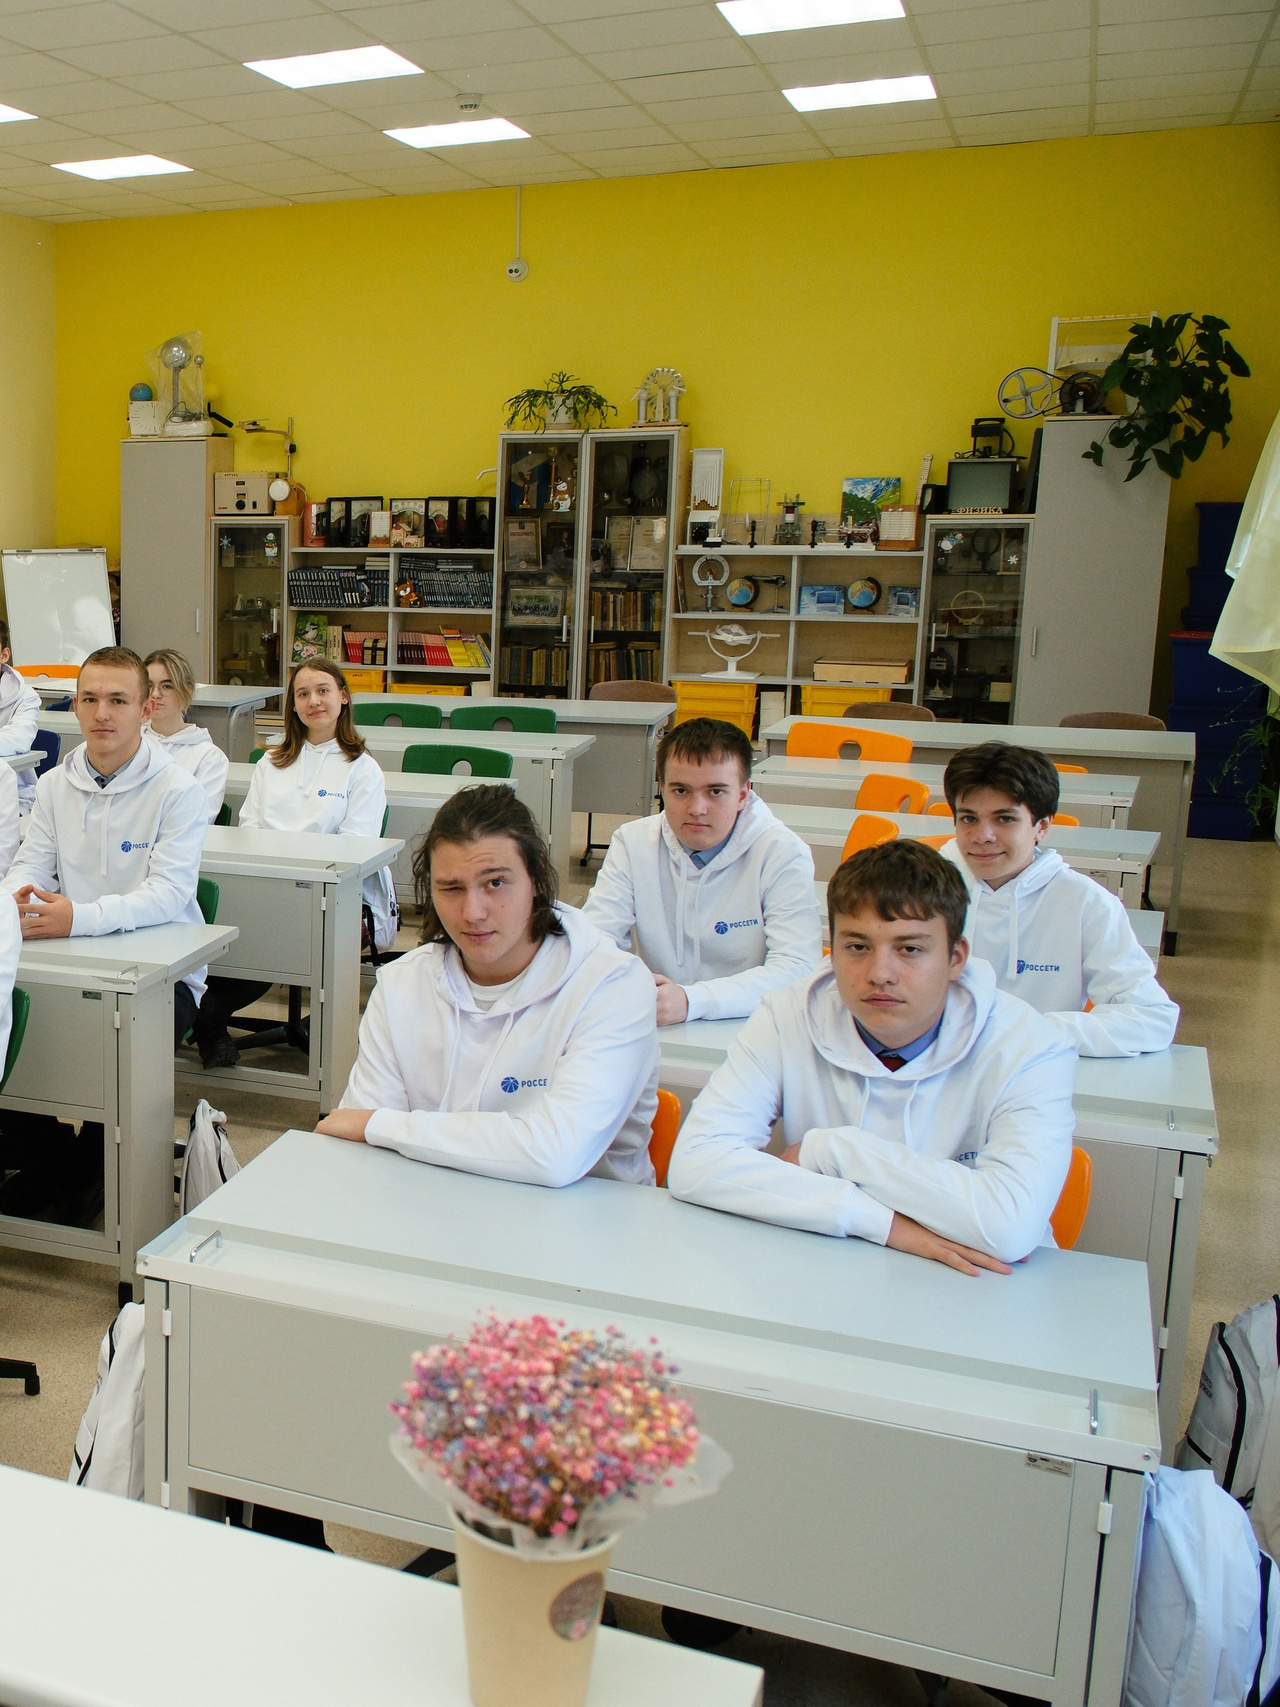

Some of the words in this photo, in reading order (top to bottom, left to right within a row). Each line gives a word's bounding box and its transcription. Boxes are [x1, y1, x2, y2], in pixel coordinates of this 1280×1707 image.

[956, 506, 1003, 515] ФИЗИКА
[729, 918, 759, 929] РОССЕТИ
[1025, 963, 1060, 972] РОССЕТИ
[521, 1078, 548, 1088] РОССЕ
